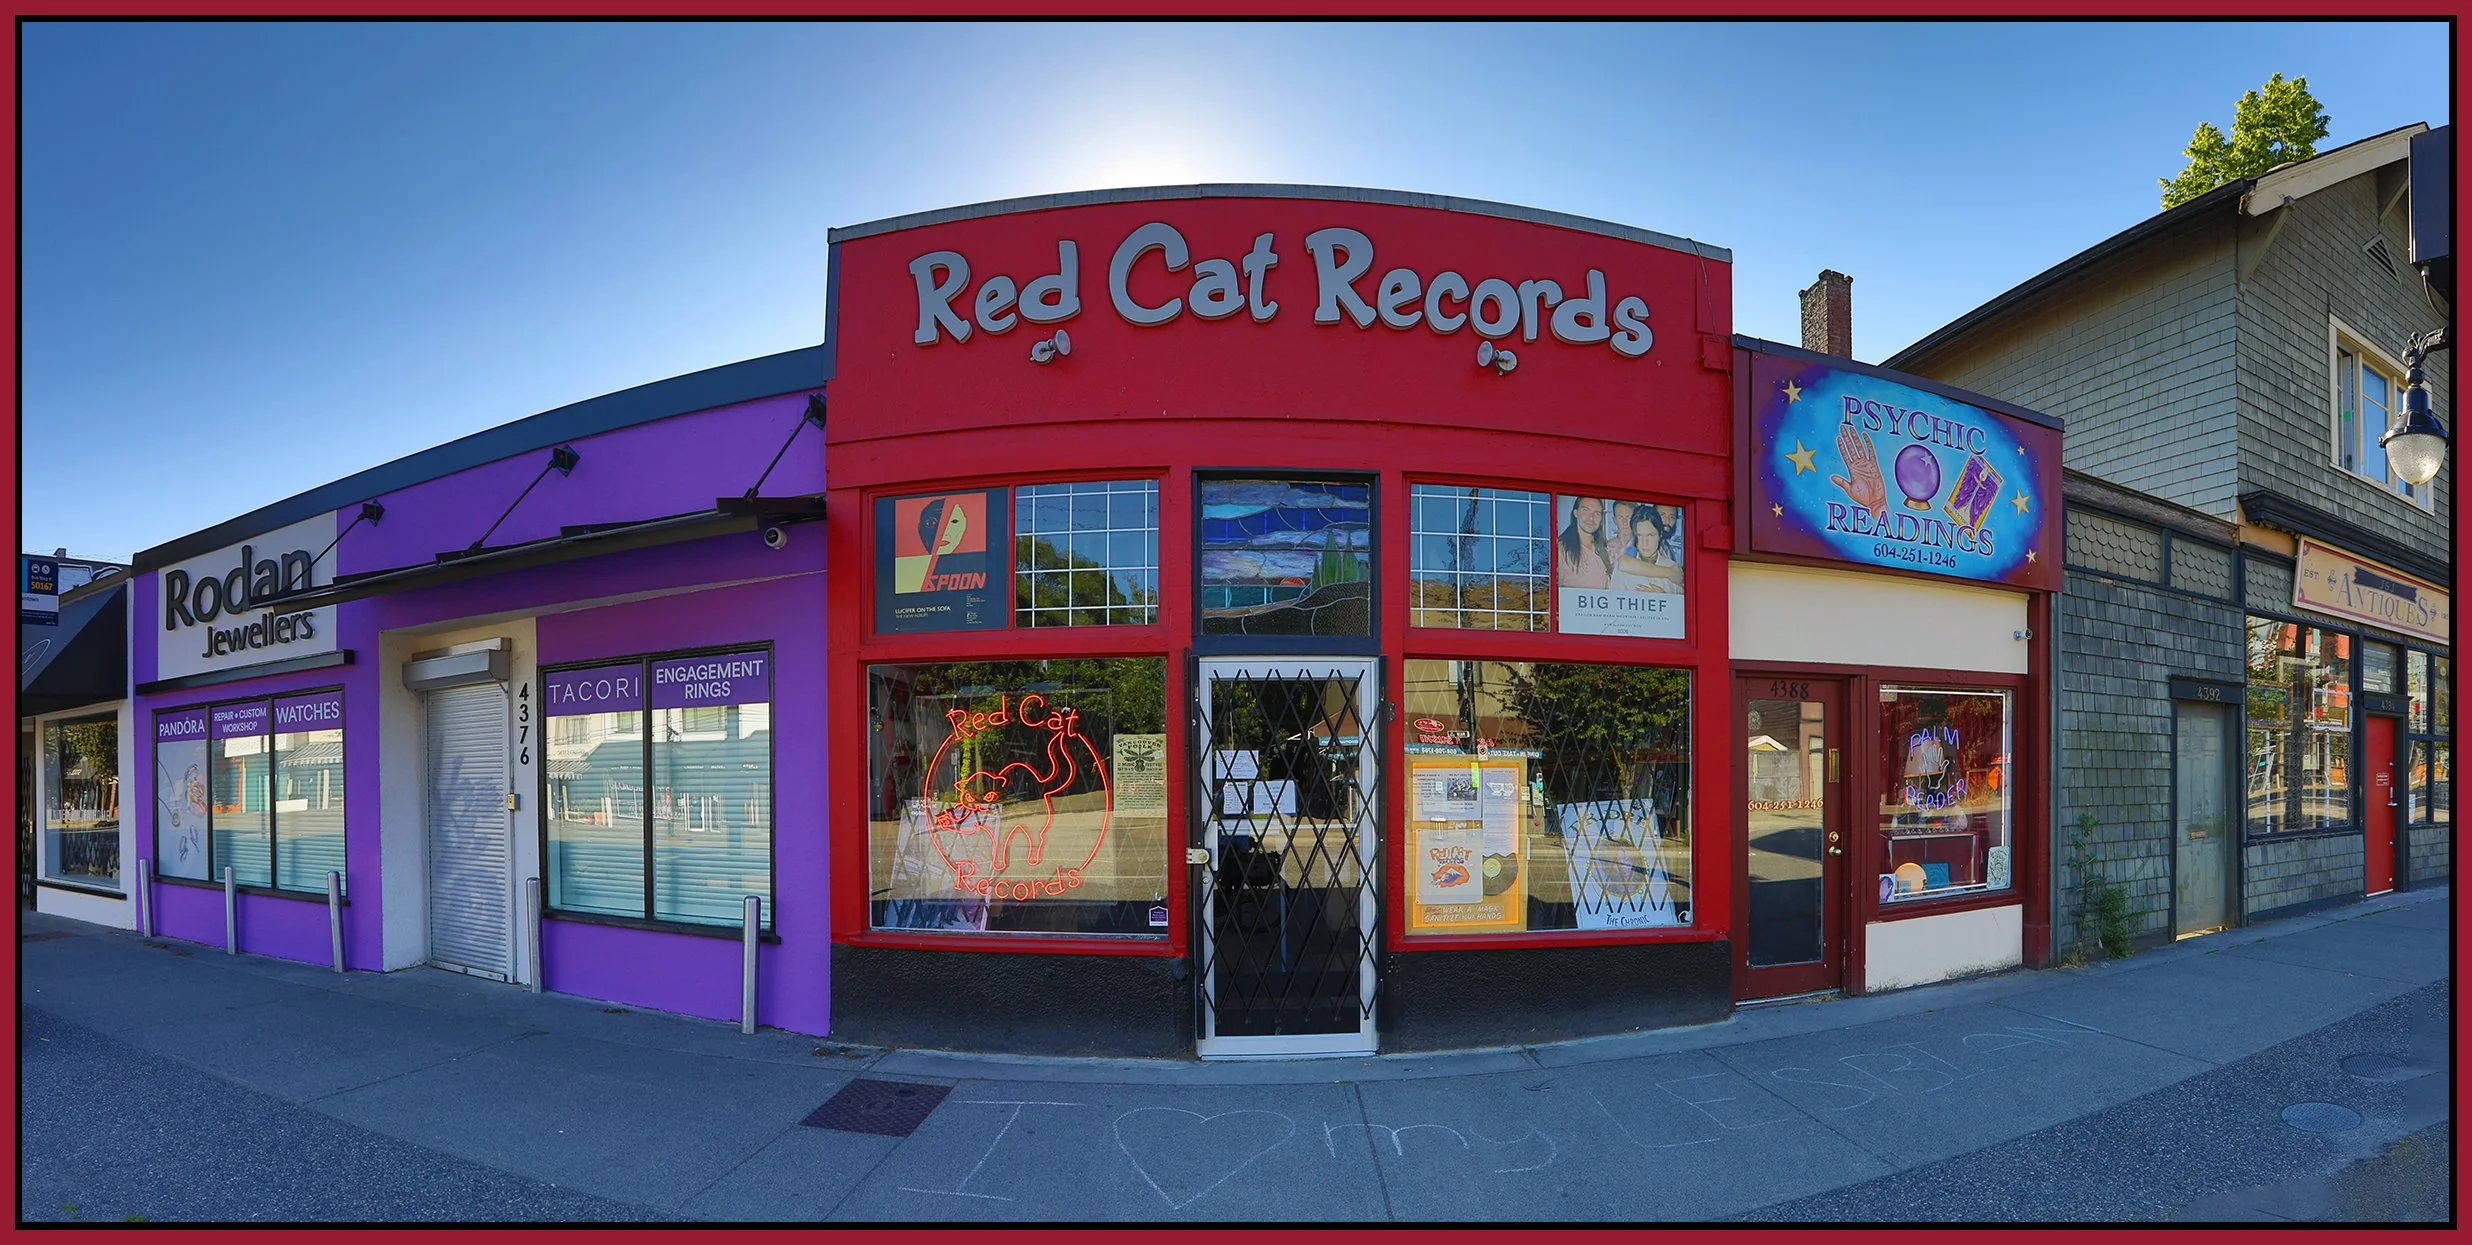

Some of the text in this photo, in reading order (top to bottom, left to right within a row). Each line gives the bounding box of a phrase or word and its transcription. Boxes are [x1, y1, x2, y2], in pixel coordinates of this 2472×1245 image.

[909, 221, 1654, 359] Red Cat Records
[1842, 395, 1987, 456] PSYCHIC
[1826, 502, 1994, 557] READINGS
[1873, 542, 1957, 569] 604-251-1246
[31, 581, 53, 591] 50167
[164, 544, 314, 631] Rodan
[921, 571, 987, 592] SPOON
[1578, 595, 1667, 612] BIG THIEF
[202, 611, 314, 658] Jewellers
[655, 659, 763, 685] ENGAGEMENT
[549, 677, 640, 704] TACORI
[684, 681, 731, 700] RINGS
[1770, 679, 1810, 700] 4388
[2197, 686, 2221, 701] 4392
[213, 707, 267, 722] REPAIR CUSTOM
[276, 701, 340, 724] WATCHES
[518, 682, 529, 767] 4376
[945, 694, 1079, 741] Red Cat
[222, 721, 258, 733] WORKSHOP
[1909, 725, 1960, 760] PALM
[1748, 797, 1824, 812] 604-251-1246
[1905, 778, 1968, 811] READER
[954, 861, 1082, 901] Records
[1606, 914, 1650, 927] THE CHRONIC
[898, 1099, 1086, 1202] I
[1323, 1121, 1558, 1174] my
